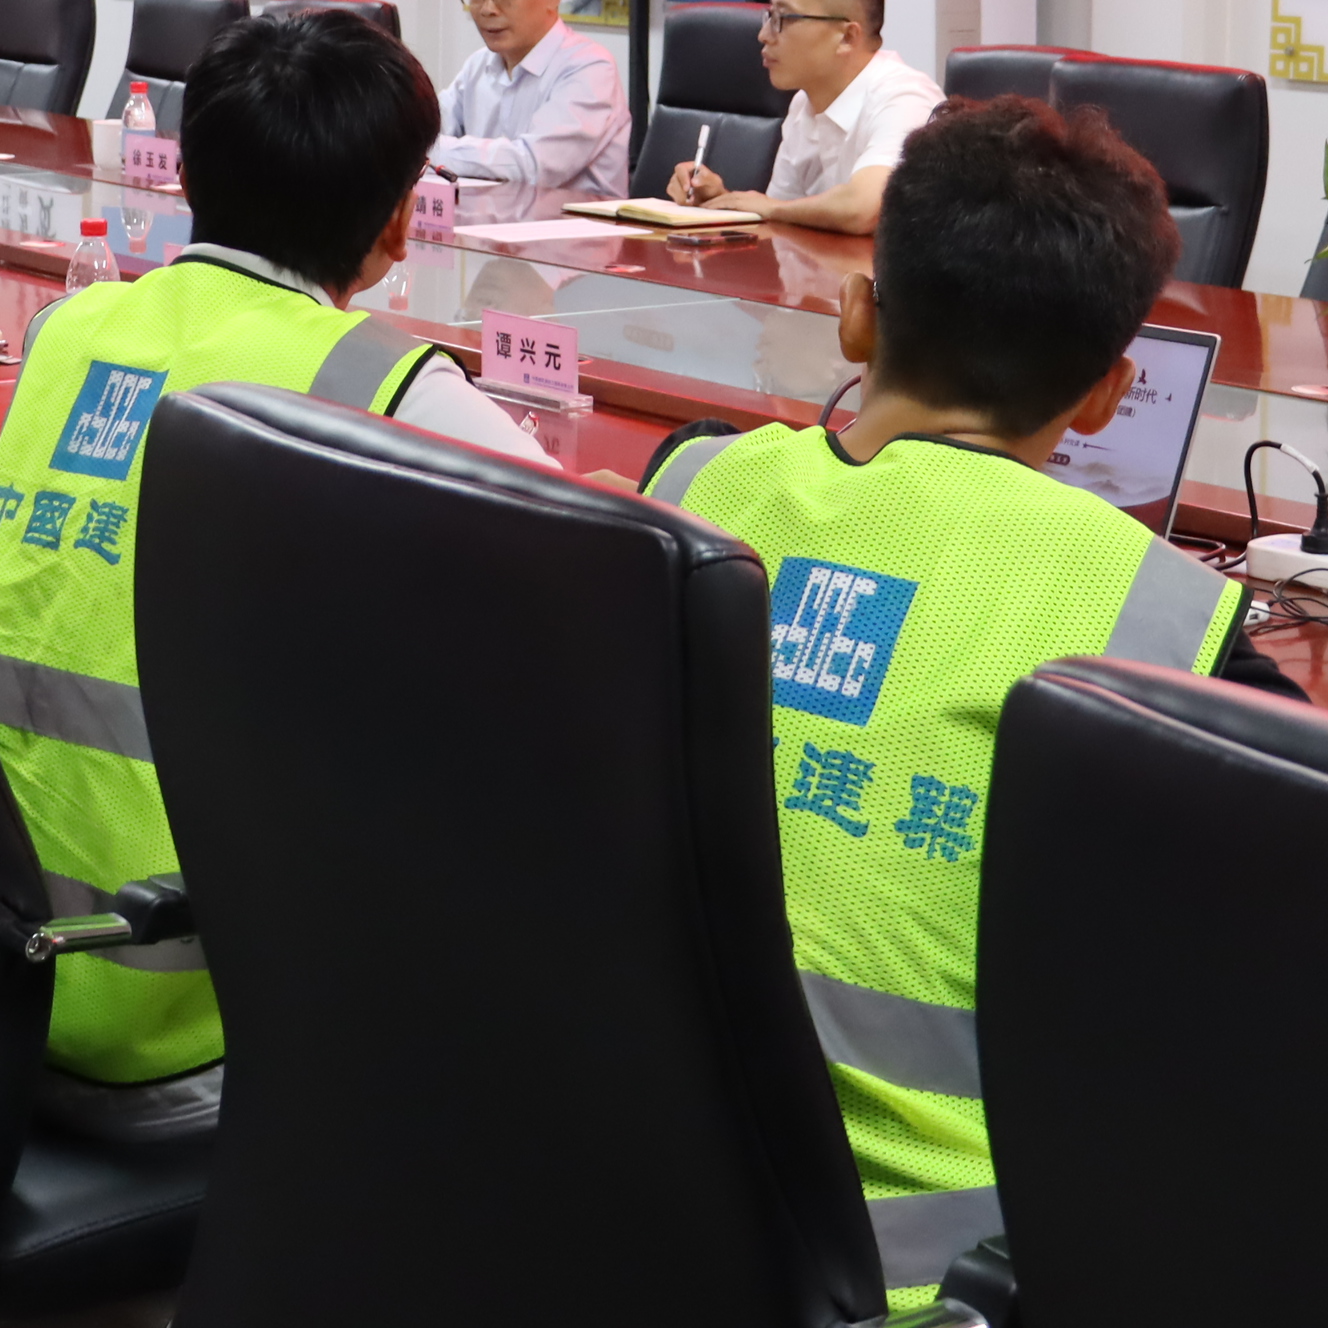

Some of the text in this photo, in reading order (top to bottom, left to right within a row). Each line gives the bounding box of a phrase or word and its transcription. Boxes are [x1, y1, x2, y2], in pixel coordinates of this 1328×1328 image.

[496, 331, 561, 371] 谭兴元
[774, 737, 979, 862] 建築
